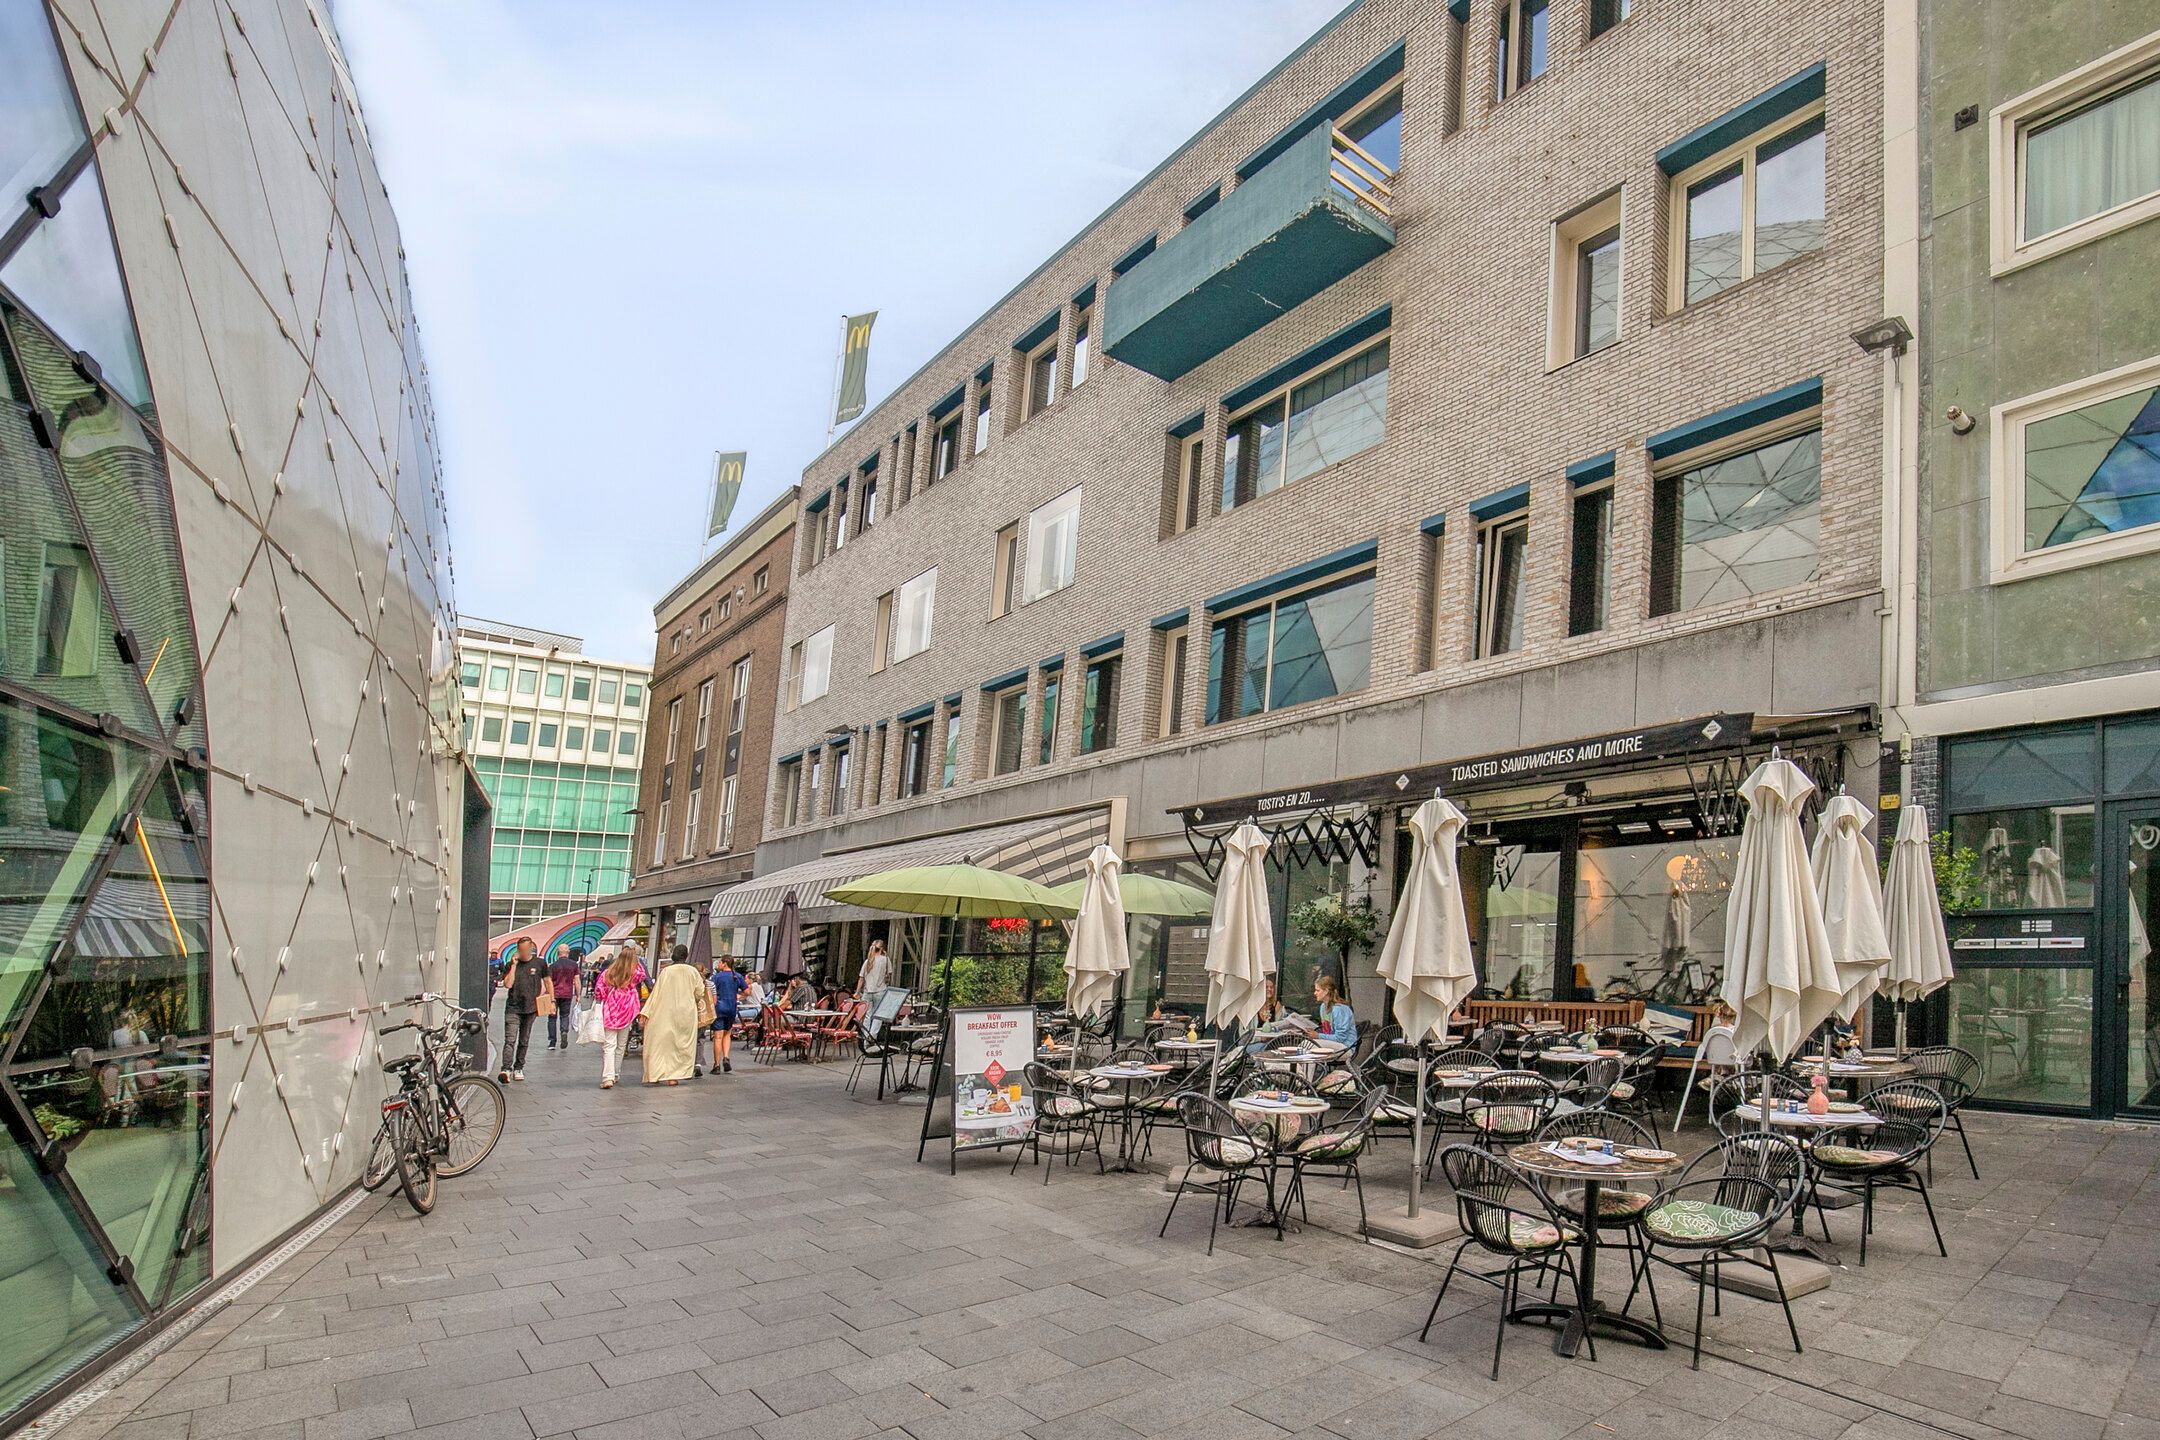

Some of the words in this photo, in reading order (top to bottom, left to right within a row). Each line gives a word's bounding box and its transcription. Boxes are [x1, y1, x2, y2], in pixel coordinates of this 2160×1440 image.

[1451, 761, 1497, 781] TOASTED
[1500, 749, 1574, 774] SANDWICHES
[1577, 743, 1601, 761] AND
[1604, 735, 1644, 757] MORE
[1257, 795, 1286, 811] TOSTI'S
[1286, 793, 1298, 807] EN
[967, 1022, 999, 1031] BREAKFAST
[1000, 1020, 1018, 1029] OFFER
